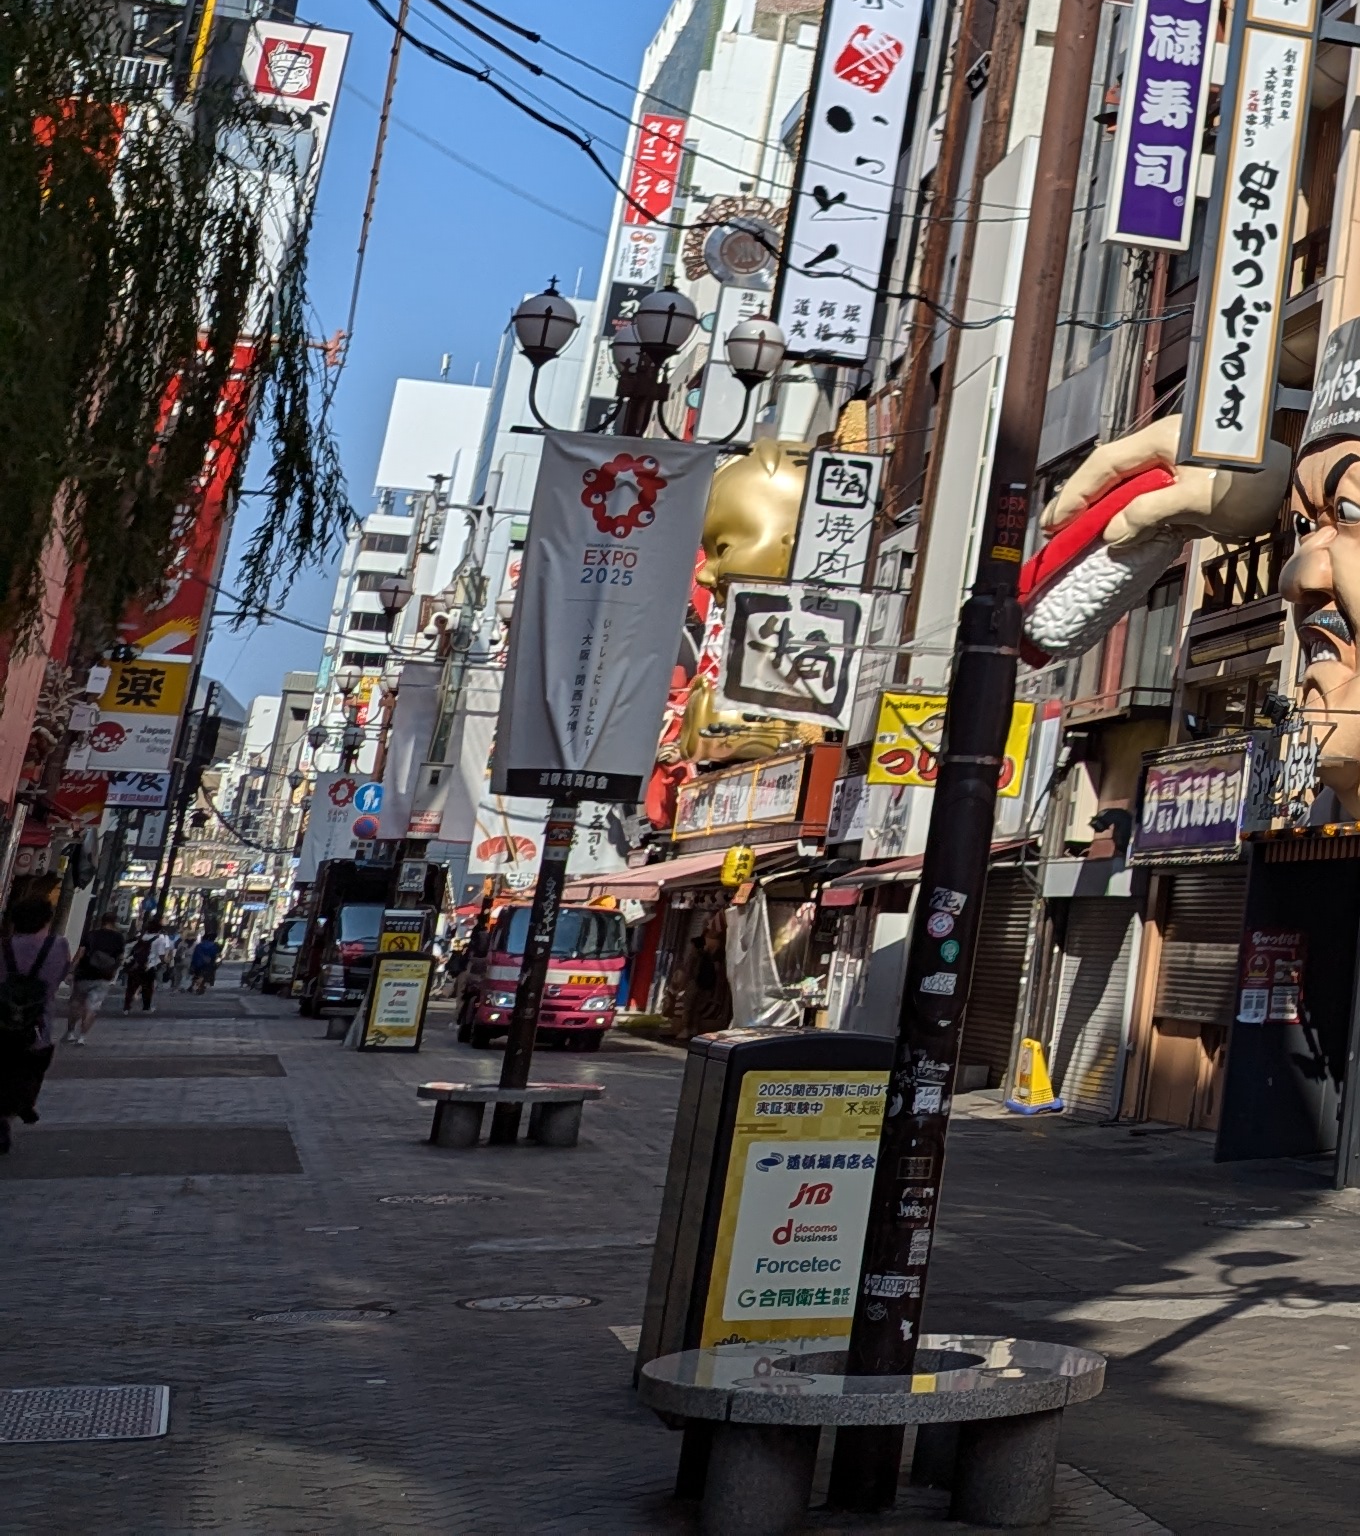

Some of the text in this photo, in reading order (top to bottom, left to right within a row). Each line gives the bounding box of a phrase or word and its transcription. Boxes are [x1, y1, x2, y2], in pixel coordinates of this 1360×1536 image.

[1214, 158, 1280, 432] 串かつだるま
[825, 466, 865, 499] 牛角
[583, 550, 638, 568] EXPO
[580, 567, 633, 586] 2025
[747, 614, 836, 693] 牛角
[115, 667, 167, 708] 薬
[756, 1101, 824, 1115] 実証実験中
[788, 1182, 834, 1210] JTB
[793, 1231, 838, 1243] business
[794, 1223, 838, 1235] docomo
[756, 1256, 842, 1275] Forcetec
[759, 1288, 832, 1309] 合同衛生
